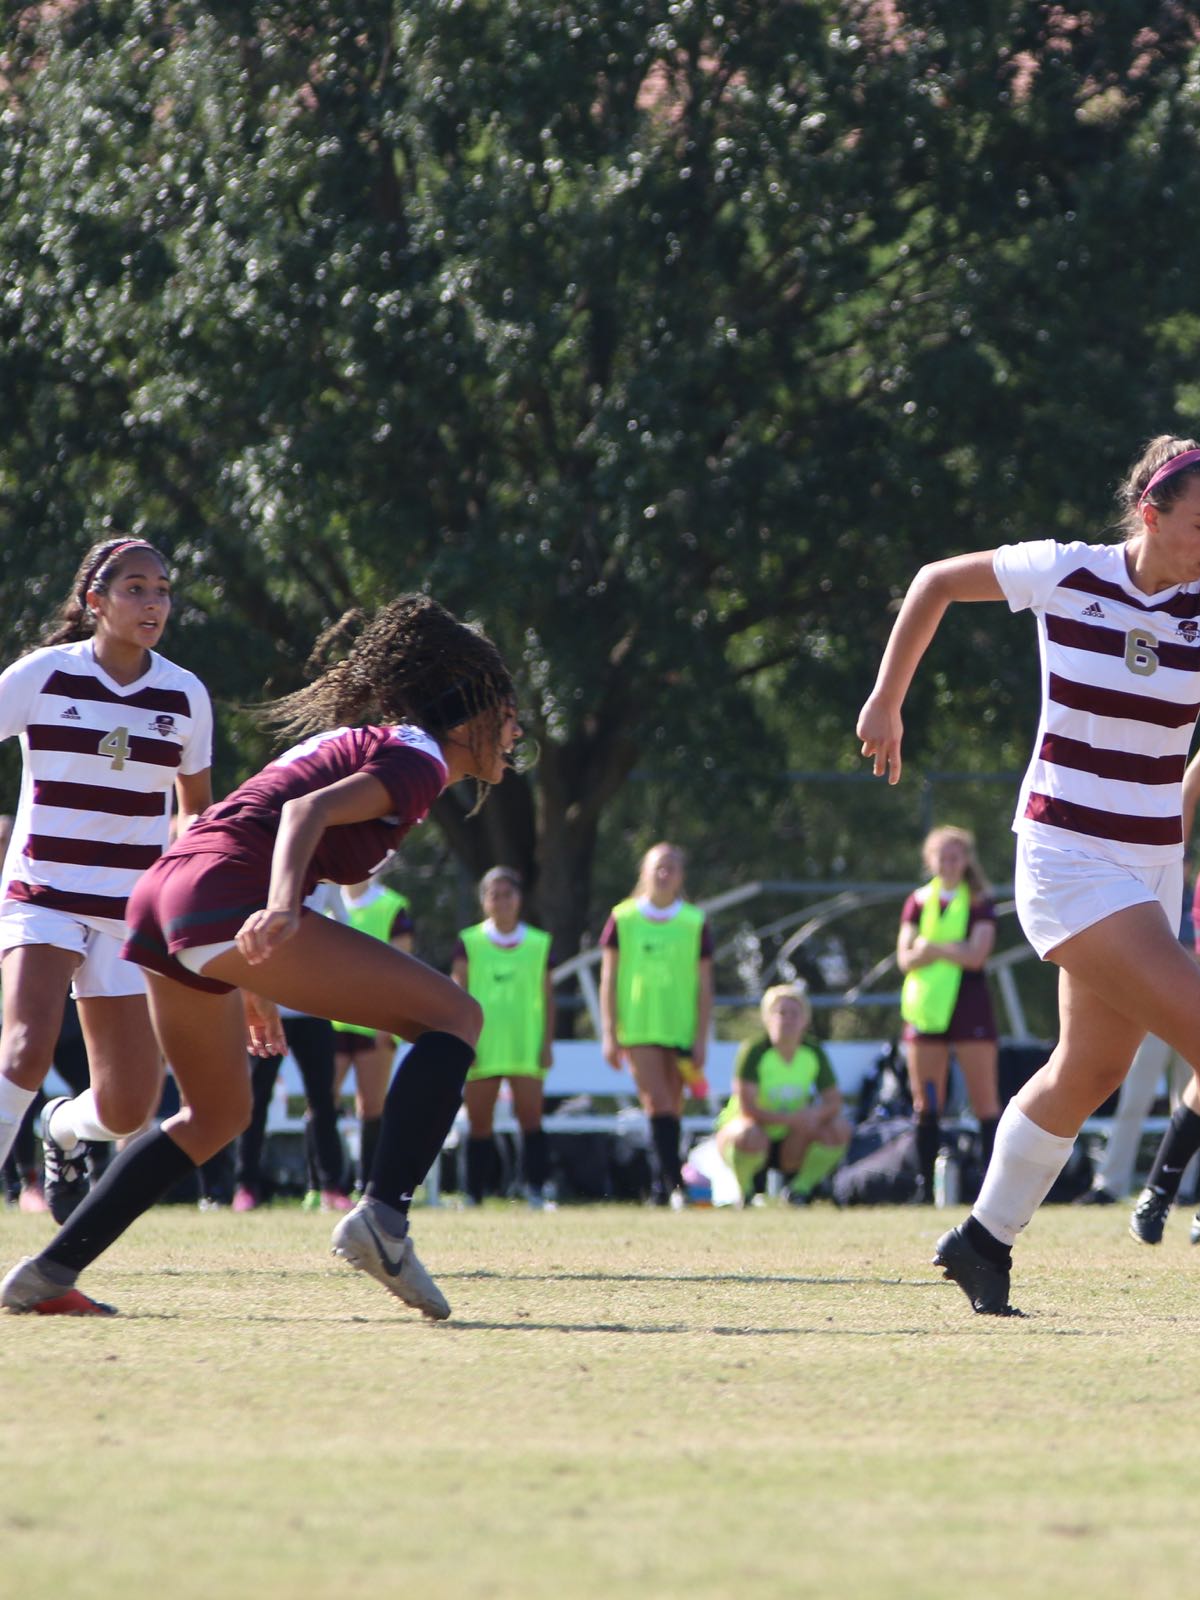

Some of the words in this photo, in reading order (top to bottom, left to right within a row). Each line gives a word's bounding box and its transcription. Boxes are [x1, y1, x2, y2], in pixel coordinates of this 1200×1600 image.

[1082, 610, 1105, 619] adidas
[1125, 628, 1159, 677] 6
[98, 726, 132, 771] 4
